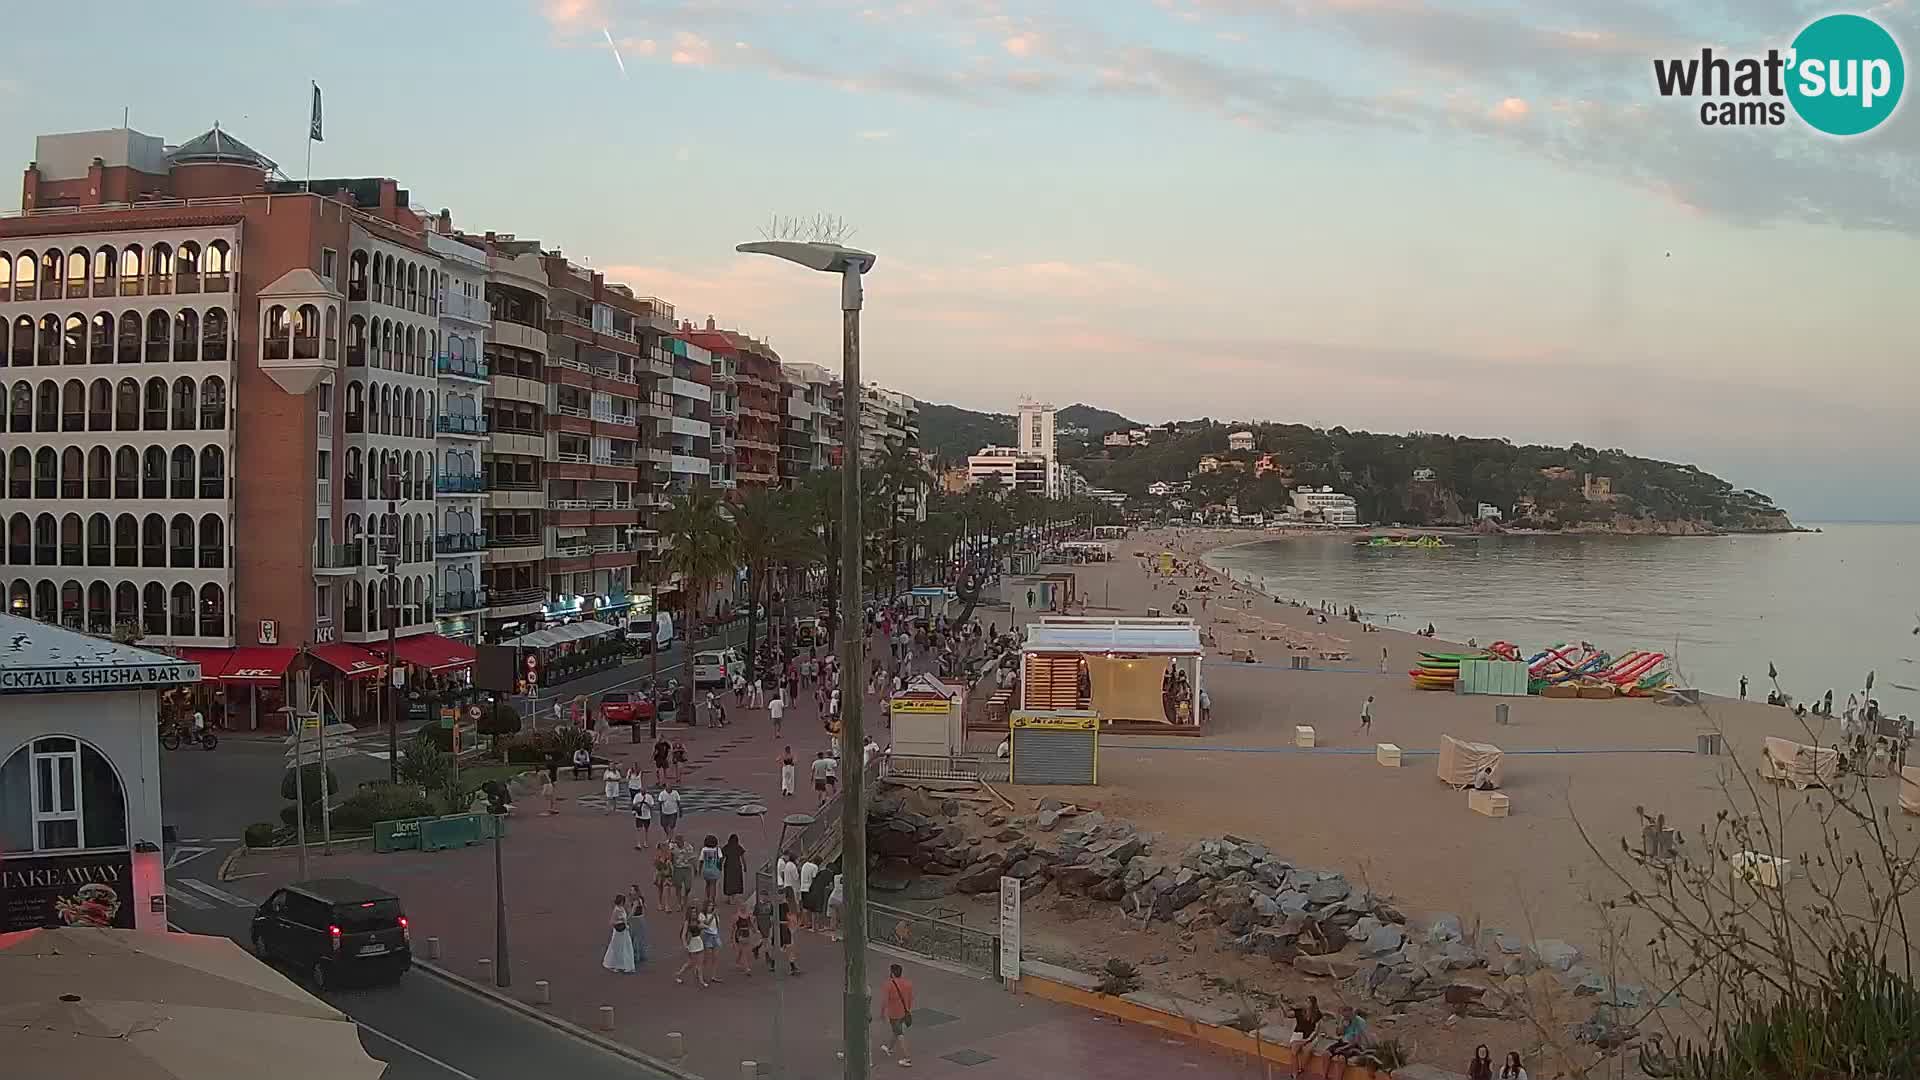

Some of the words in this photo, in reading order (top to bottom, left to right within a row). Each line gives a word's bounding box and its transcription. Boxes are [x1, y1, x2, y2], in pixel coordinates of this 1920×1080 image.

[316, 626, 335, 643] KFC
[2, 672, 61, 687] CKTAIL
[66, 671, 77, 685] &
[82, 669, 143, 685] SHISHA
[148, 667, 181, 682] BAR
[235, 668, 273, 676] KFC
[0, 864, 123, 888] TAKEAWAY
